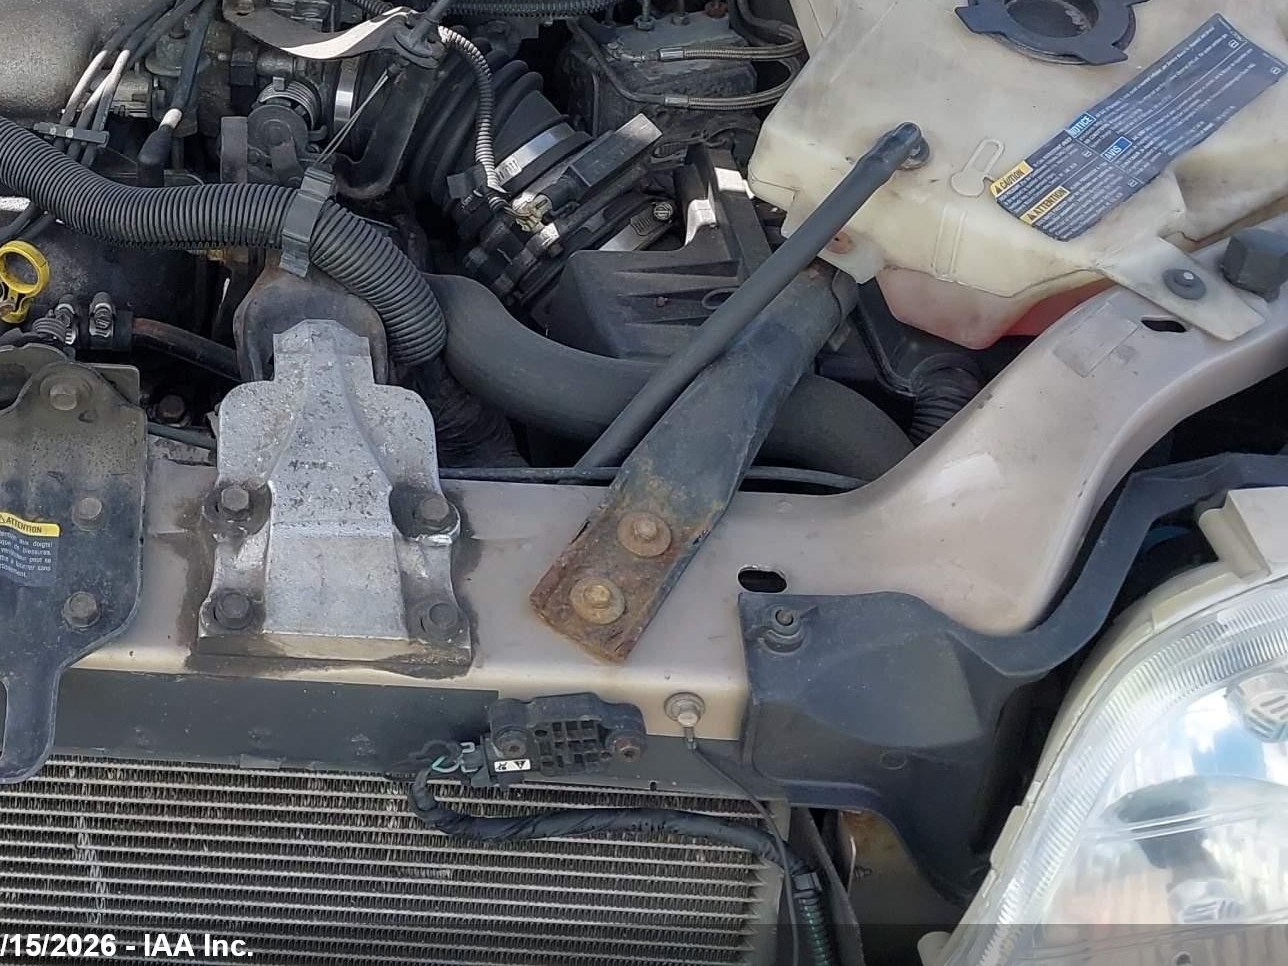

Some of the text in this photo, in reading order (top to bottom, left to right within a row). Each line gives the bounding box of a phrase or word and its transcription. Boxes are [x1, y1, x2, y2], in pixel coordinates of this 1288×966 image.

[1069, 115, 1093, 138] NOTICE
[1103, 145, 1122, 162] AVIS
[1000, 169, 1026, 187] CAUTION
[1032, 187, 1067, 217] ATTENTION
[6, 516, 42, 533] ATTENTION
